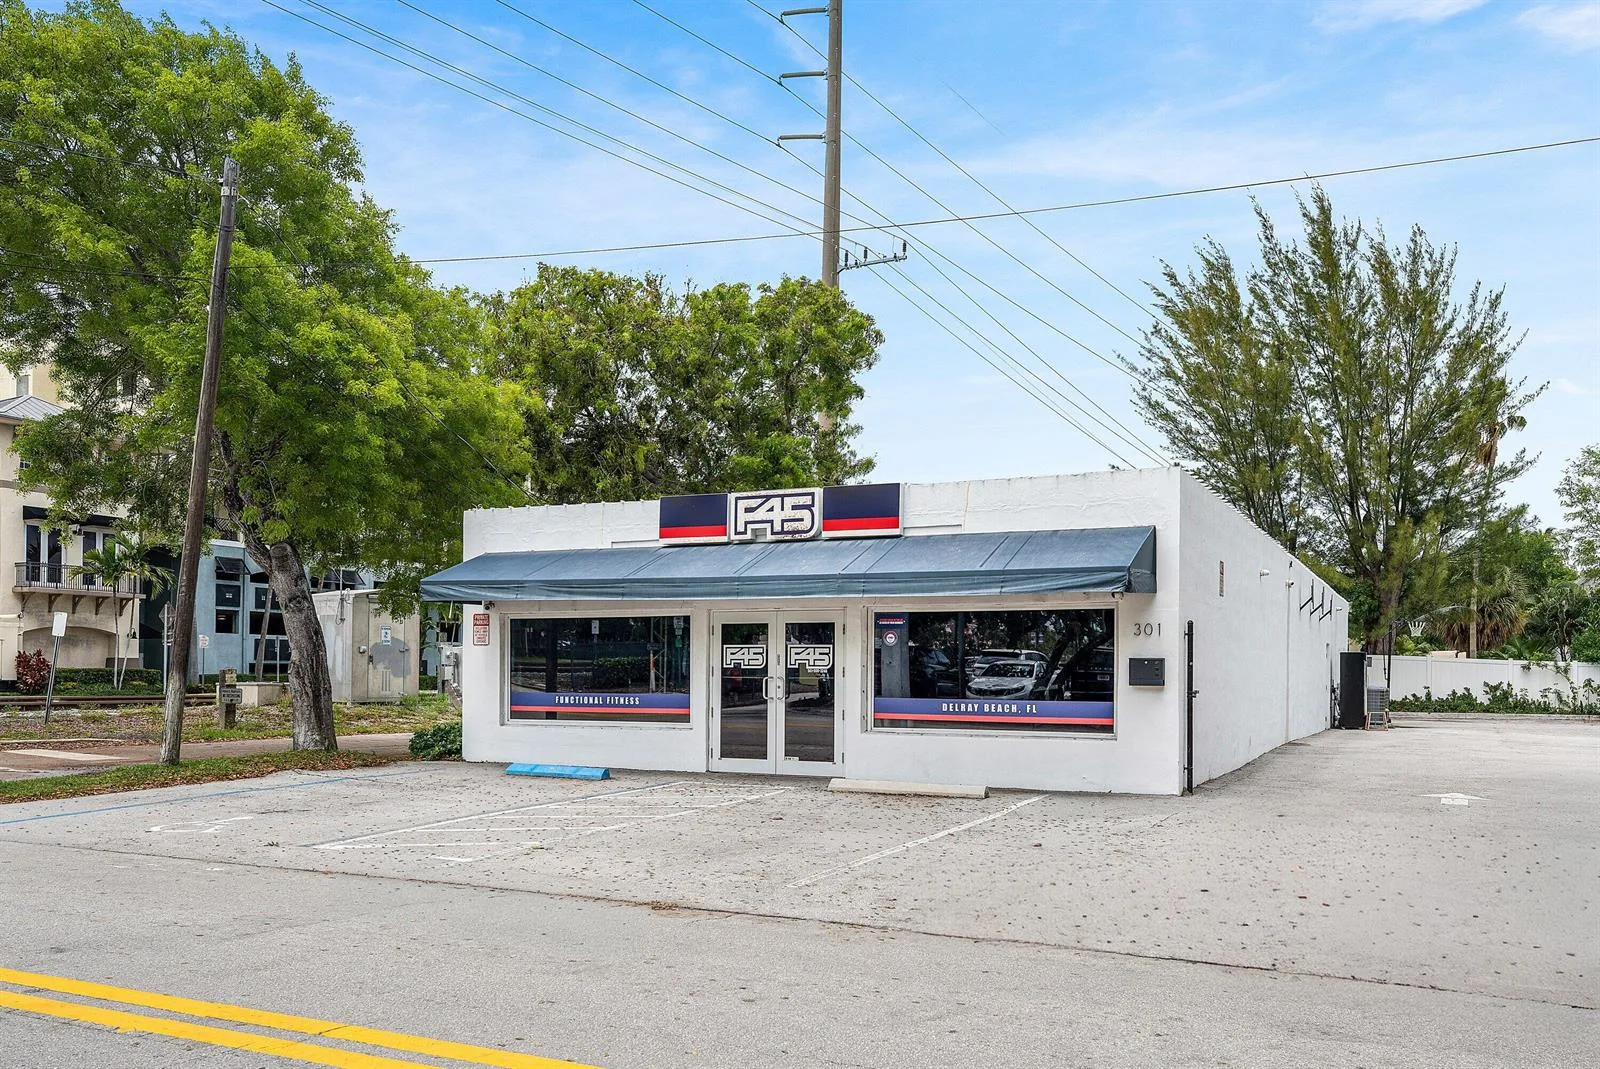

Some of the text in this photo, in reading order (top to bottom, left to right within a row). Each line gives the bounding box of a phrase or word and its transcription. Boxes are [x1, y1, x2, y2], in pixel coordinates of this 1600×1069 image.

[734, 493, 815, 535] F45
[1133, 622, 1161, 637] 301
[724, 645, 766, 668] F45
[788, 645, 832, 668] F45
[555, 695, 640, 706] FUNCTIONAL FITNESS
[942, 702, 1037, 714] DELRAY BEACH, FL
